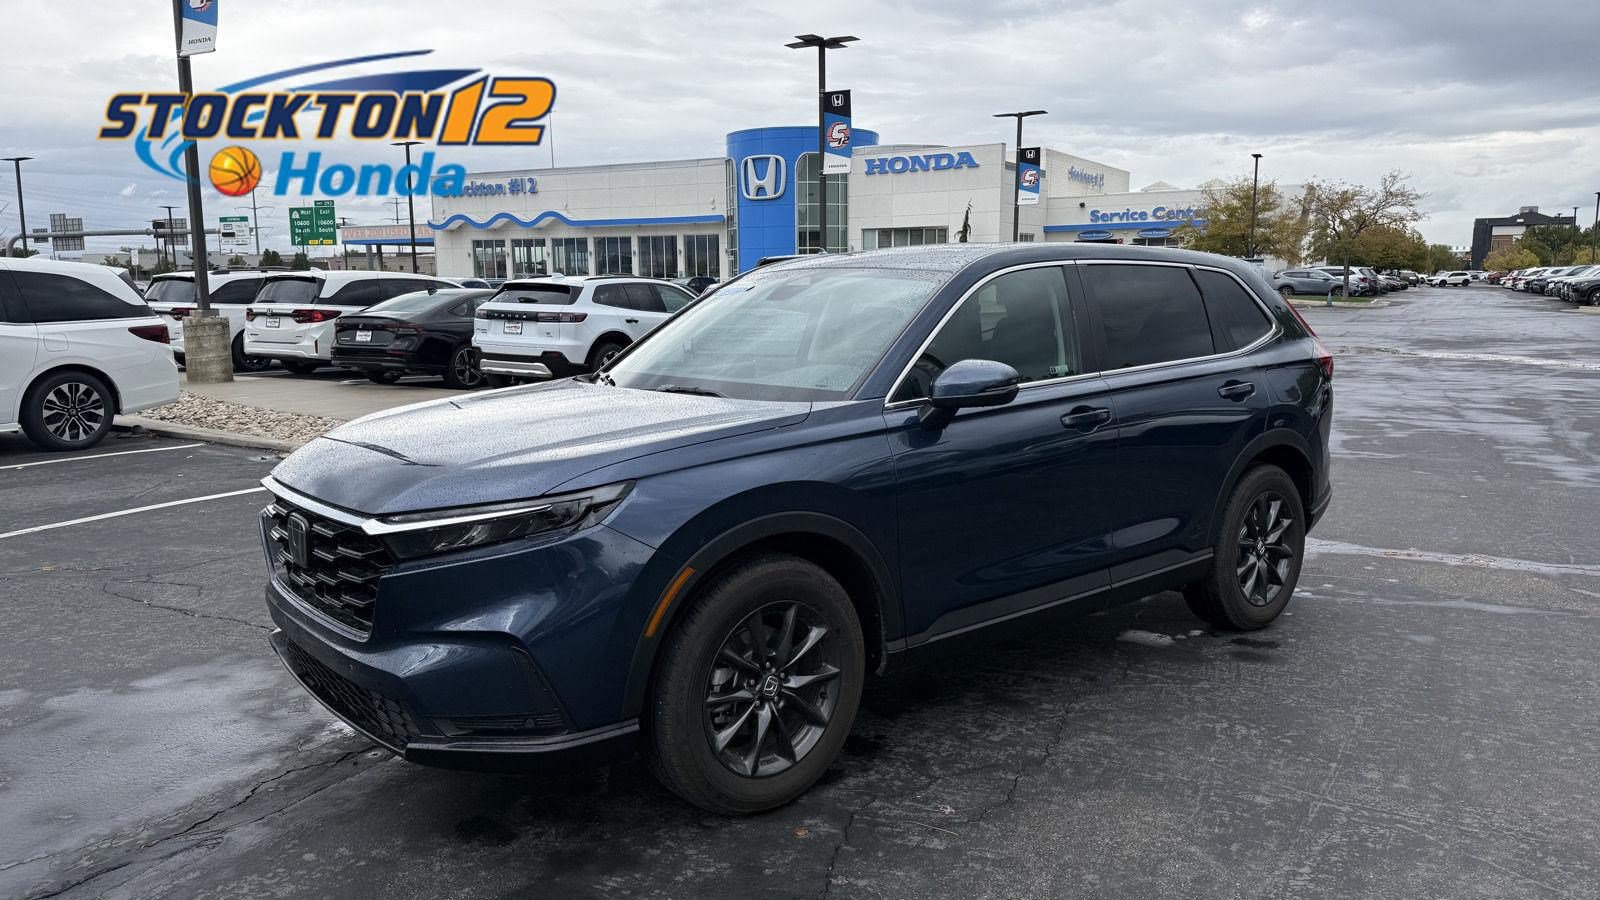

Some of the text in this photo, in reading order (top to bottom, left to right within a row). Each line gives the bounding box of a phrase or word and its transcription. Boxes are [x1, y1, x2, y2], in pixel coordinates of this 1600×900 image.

[188, 36, 212, 45] HONDA
[864, 150, 980, 176] HONDA
[508, 177, 539, 195] #12
[1090, 208, 1149, 223] Service
